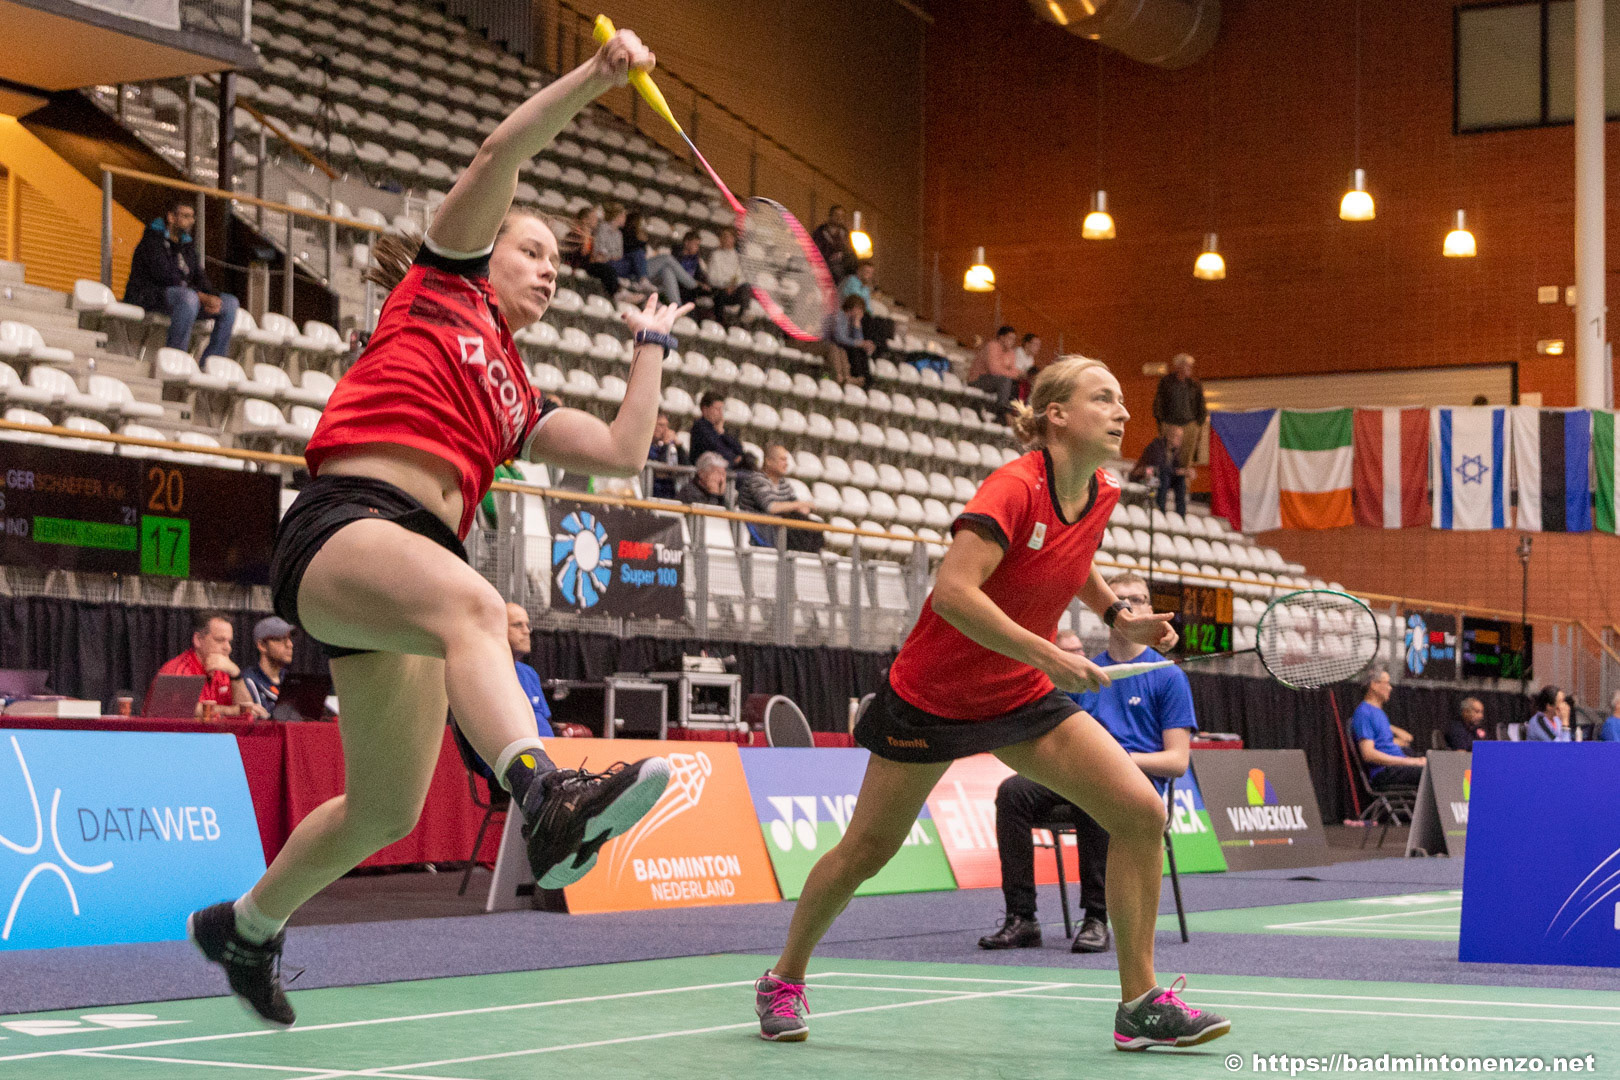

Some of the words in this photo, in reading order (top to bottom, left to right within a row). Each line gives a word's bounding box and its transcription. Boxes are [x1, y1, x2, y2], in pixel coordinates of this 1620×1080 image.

[6, 469, 35, 490] GER
[149, 467, 183, 513] 20
[5, 517, 29, 537] IND
[151, 526, 183, 569] 17
[654, 543, 683, 565] Tour
[621, 563, 656, 588] Super
[657, 567, 678, 587] 100
[886, 736, 929, 749] TeamNL
[78, 806, 221, 842] DATAWEB
[1226, 805, 1308, 832] VANDEKOLK
[632, 855, 741, 881] BADMINTON
[651, 879, 736, 901] NEDERLAND
